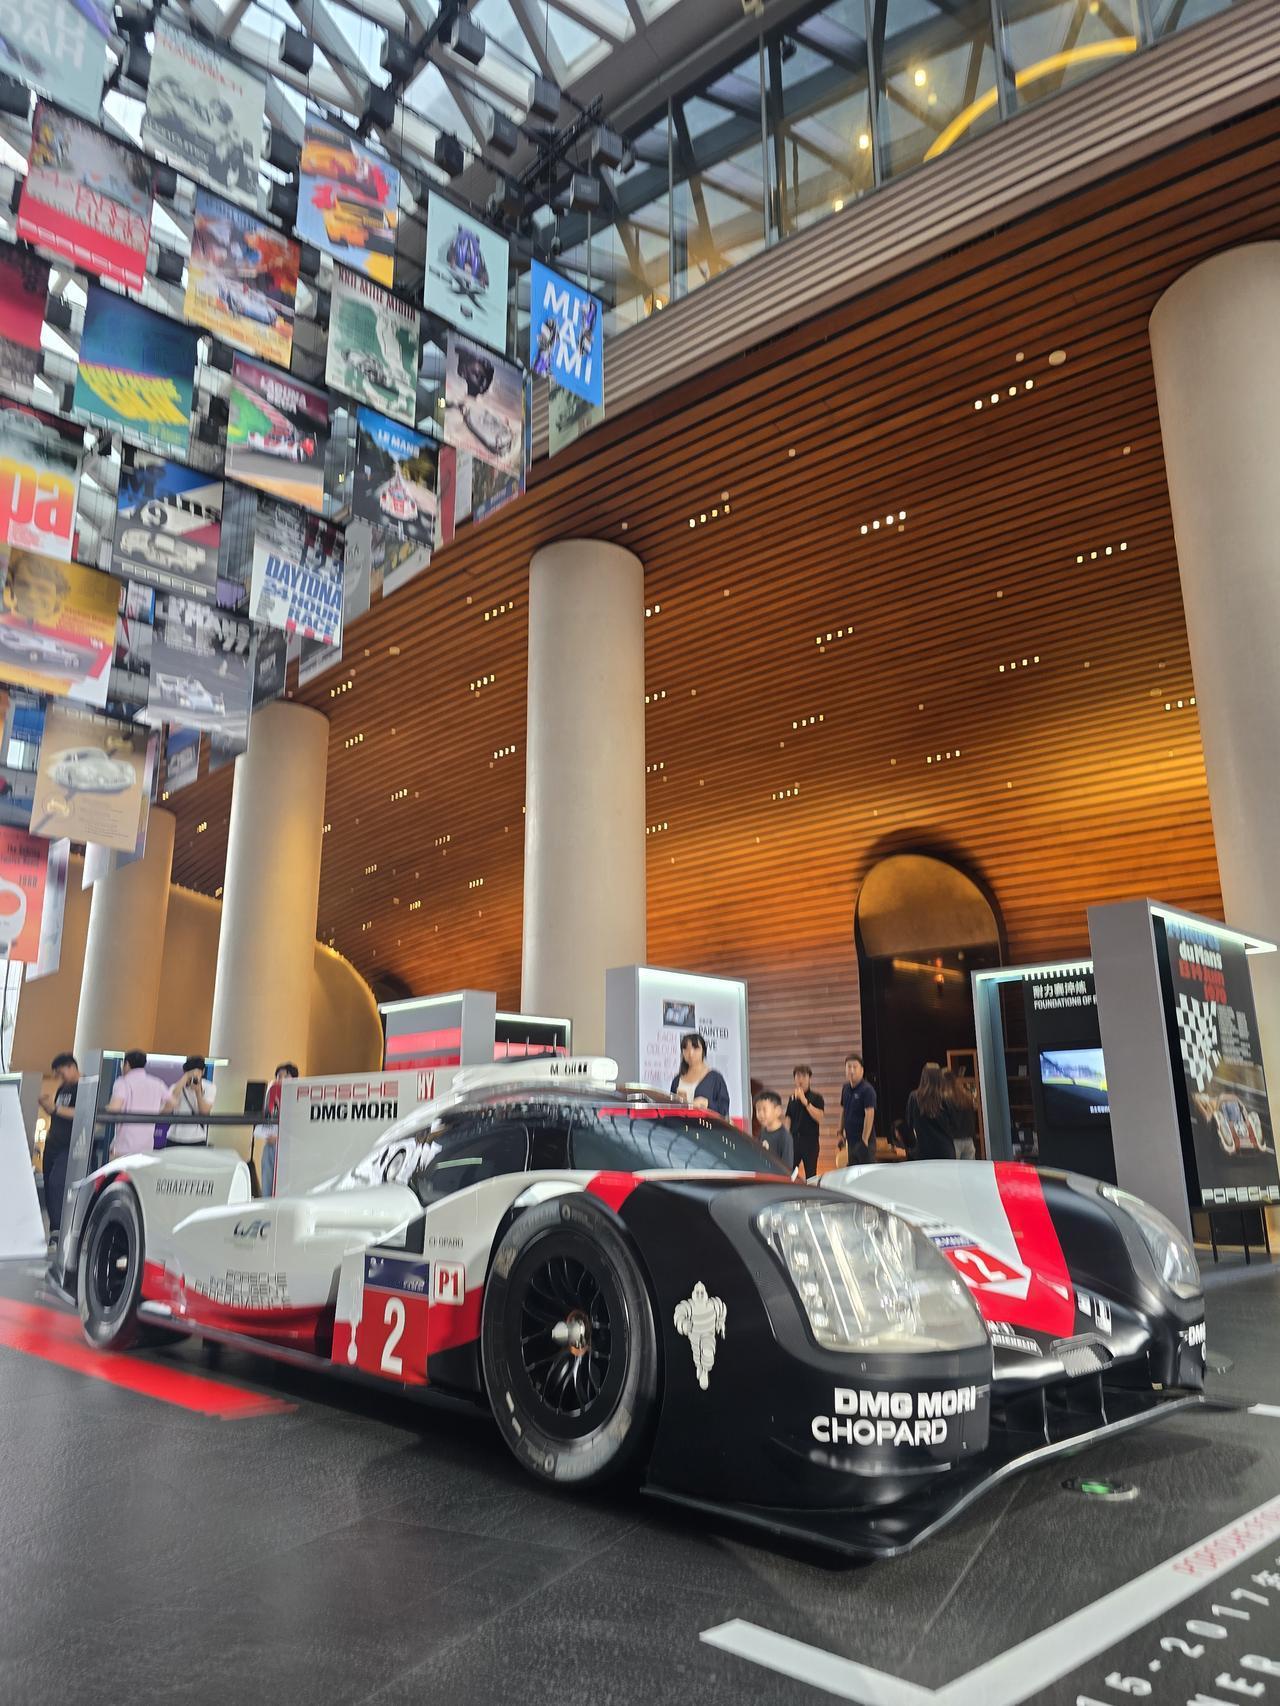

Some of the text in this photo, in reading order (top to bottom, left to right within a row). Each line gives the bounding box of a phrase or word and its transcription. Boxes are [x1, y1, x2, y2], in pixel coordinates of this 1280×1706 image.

[558, 318, 577, 348] A
[556, 342, 593, 386] MI
[265, 552, 342, 612] DAYTONA
[1034, 995, 1081, 1010] FOUNDATIONS
[1082, 995, 1092, 1006] OF
[699, 1026, 728, 1039] PAINTED
[297, 1080, 399, 1102] PORSCHE
[417, 1071, 434, 1101] HY
[310, 1100, 398, 1121] DMG MORI
[1201, 1185, 1280, 1205] PORSCHE
[226, 1269, 287, 1284] PORSCHE
[953, 1249, 1008, 1282] 2
[440, 1269, 459, 1298] P1
[381, 1296, 406, 1376] 2
[834, 1385, 976, 1419] DMG MORI
[811, 1415, 948, 1447] CHOPARD
